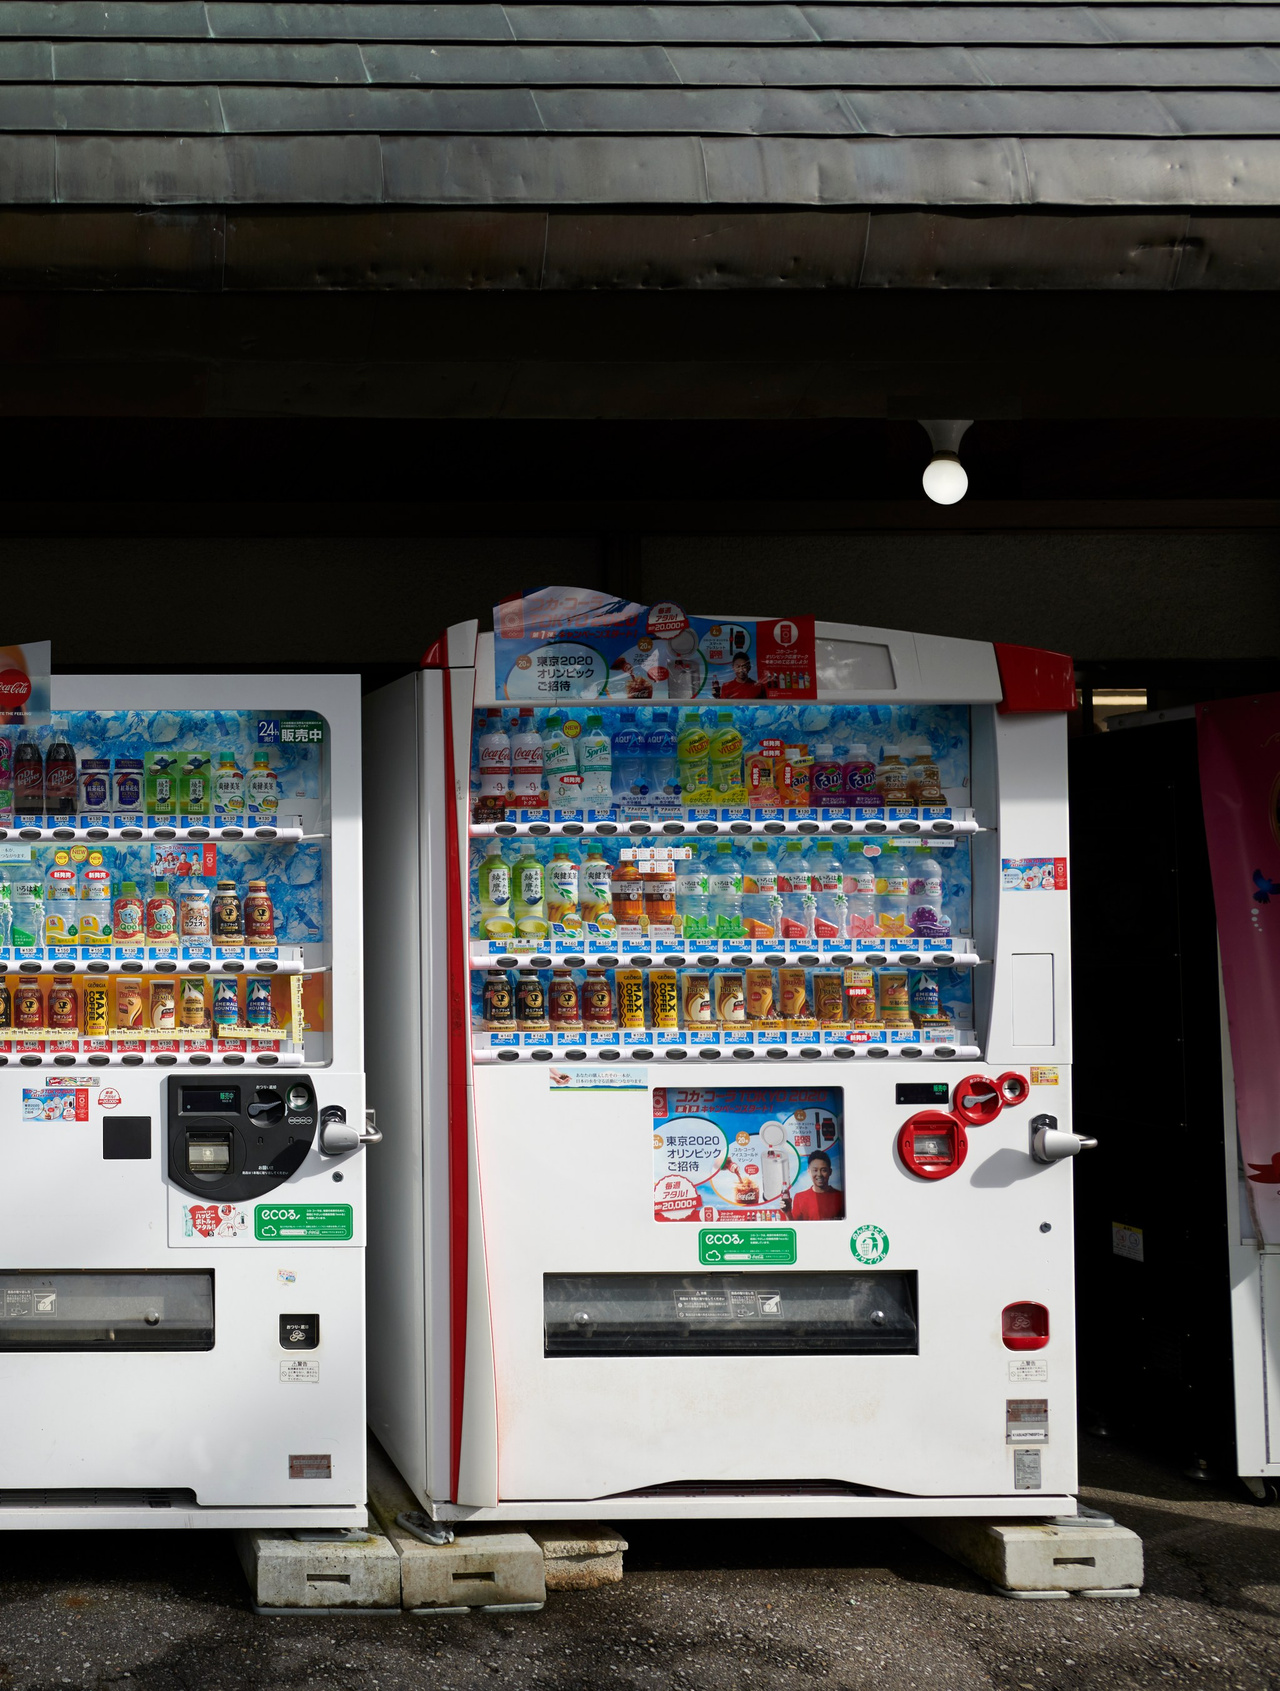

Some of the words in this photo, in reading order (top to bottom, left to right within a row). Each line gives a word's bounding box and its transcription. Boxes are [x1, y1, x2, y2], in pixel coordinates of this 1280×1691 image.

[528, 595, 605, 611] コカ・コーラ
[528, 613, 590, 628] TOKYO
[591, 612, 639, 627] 2020
[656, 614, 678, 622] アタル!
[558, 630, 639, 639] キャンペーンスタート!
[536, 655, 593, 666] 東京2020
[537, 669, 595, 679] オリンピック
[538, 681, 571, 692] ご招待
[281, 729, 322, 742] 販売中
[545, 747, 566, 763] Sprite
[586, 746, 608, 759] Sprite
[58, 769, 69, 779] Dr
[120, 923, 137, 931] Qoo
[155, 923, 171, 931] Qoo
[625, 982, 633, 1013] COFFEE
[659, 982, 667, 1013] COFFEE
[849, 988, 867, 996] 新発売
[633, 983, 642, 1013] MAX
[667, 983, 676, 1013] MAX
[88, 990, 96, 1020] COFFEE
[96, 990, 105, 1020] MAX
[676, 1091, 738, 1103] コカ・コーラ
[739, 1090, 787, 1102] TOKYO
[789, 1090, 828, 1102] 2020
[700, 1105, 773, 1113] キャンペーンスタート!
[666, 1136, 720, 1147] 東京2020
[667, 1149, 722, 1159] オリンピック
[668, 1161, 699, 1172] ご招待
[665, 1181, 681, 1190] 毎週
[662, 1189, 688, 1199] アタル!
[852, 1225, 887, 1240] のんだあとは
[853, 1252, 887, 1265] リサイクル
